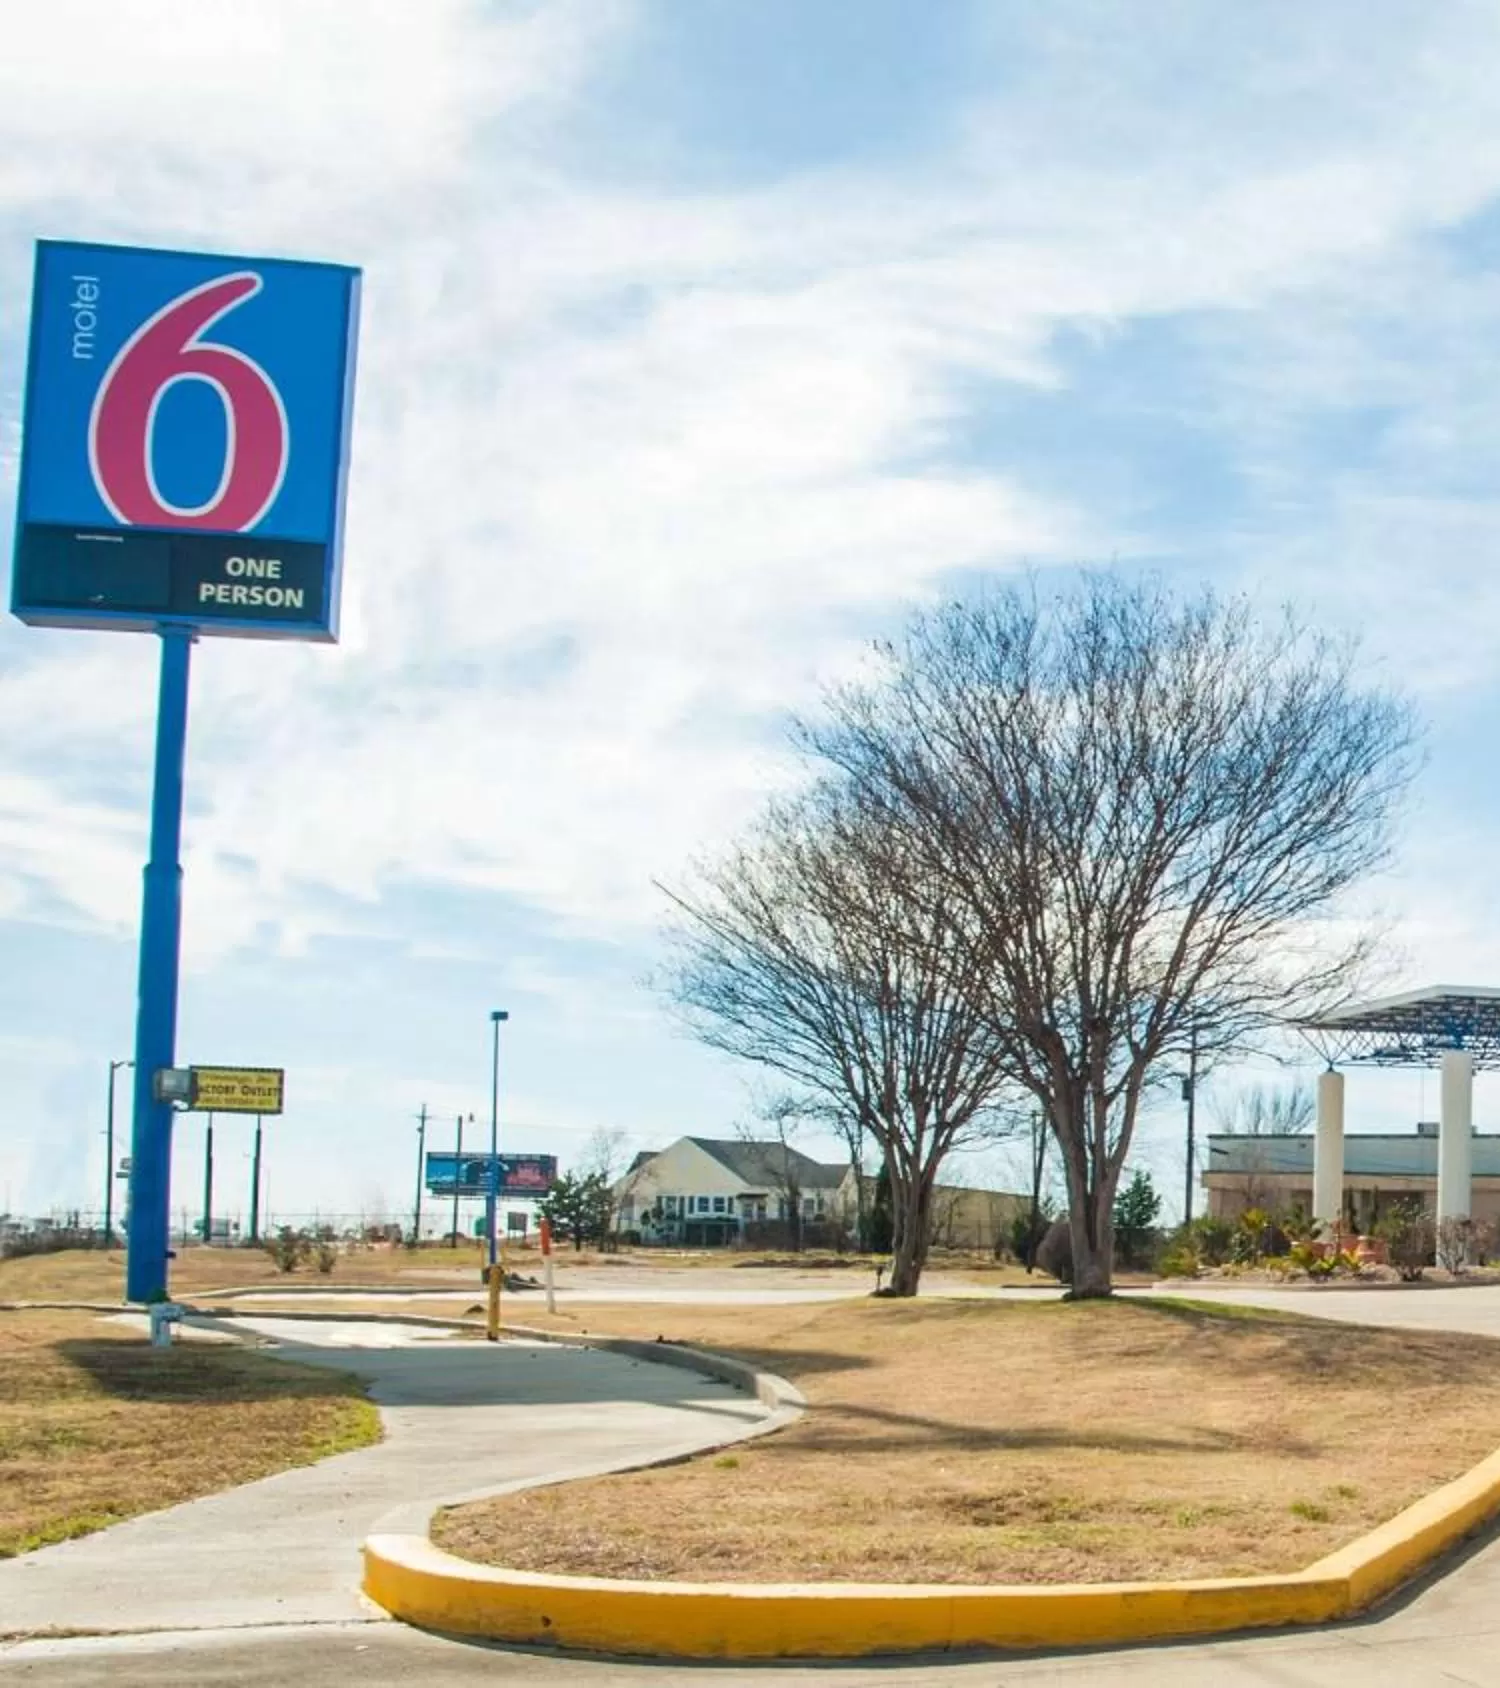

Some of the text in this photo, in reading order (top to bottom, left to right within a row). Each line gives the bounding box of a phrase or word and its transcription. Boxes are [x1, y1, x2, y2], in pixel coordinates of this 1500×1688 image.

[71, 274, 100, 359] motel
[88, 270, 290, 533] 6
[226, 557, 282, 579] ONE
[199, 583, 304, 608] PERSON
[198, 1083, 237, 1095] ACTORY
